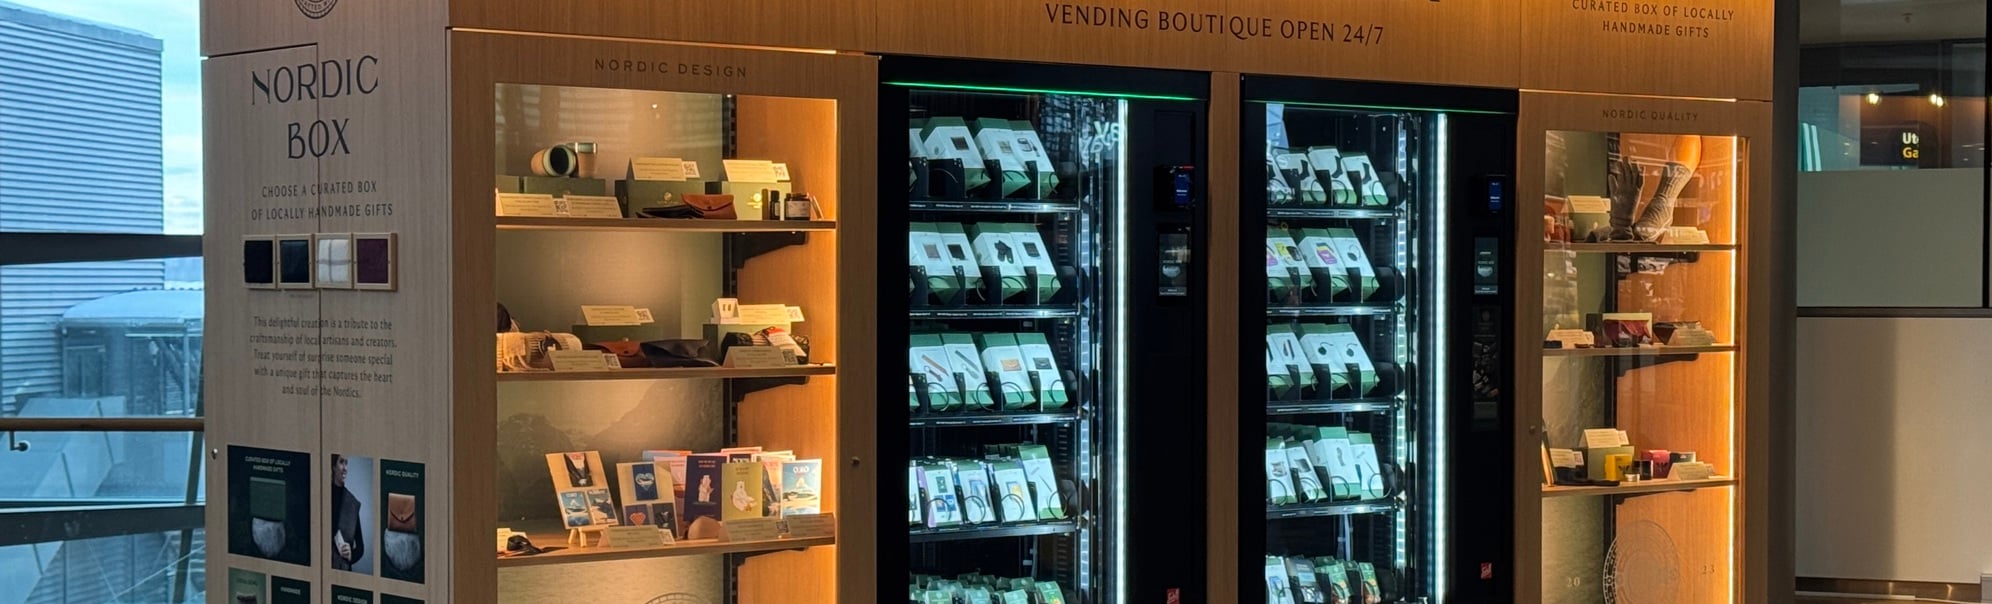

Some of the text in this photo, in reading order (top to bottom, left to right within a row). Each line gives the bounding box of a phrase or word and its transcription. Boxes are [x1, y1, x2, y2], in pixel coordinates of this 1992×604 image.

[1572, 0, 1734, 20] CURATED BOX OF LOCALLY
[1046, 4, 1383, 46] VENDING BOUTIQUE OPEN 24/7
[1603, 21, 1709, 38] HANDMADE GIFTS
[595, 59, 746, 78] NORDIC DESIGN
[252, 55, 379, 105] NORDIC
[1602, 109, 1698, 120] NORDIC QUALITY
[288, 118, 350, 159] BOX
[262, 181, 376, 198] CHOOSE A CURATED BOX
[252, 204, 393, 220] OF LOCALLY HANDMADE GIFTS
[254, 316, 267, 327] This
[268, 317, 299, 329] delightful
[331, 319, 336, 328] is
[344, 319, 368, 329] tribute
[371, 320, 378, 330] to
[380, 319, 392, 330] the
[250, 334, 294, 345] craftsmanship
[296, 336, 303, 345] of
[323, 336, 349, 345] artisans
[351, 336, 364, 346] and
[366, 338, 397, 348] creators.
[254, 349, 270, 360] Treat
[272, 351, 297, 362] yourself
[336, 354, 366, 364] someone
[368, 354, 393, 366] special
[254, 367, 268, 376] with
[276, 369, 297, 379] unique
[299, 369, 311, 381] gift
[329, 371, 358, 381] captures
[360, 370, 372, 381] the
[374, 371, 393, 383] heart
[282, 385, 294, 395] and
[296, 385, 309, 395] soul
[333, 386, 361, 398] Nordics.
